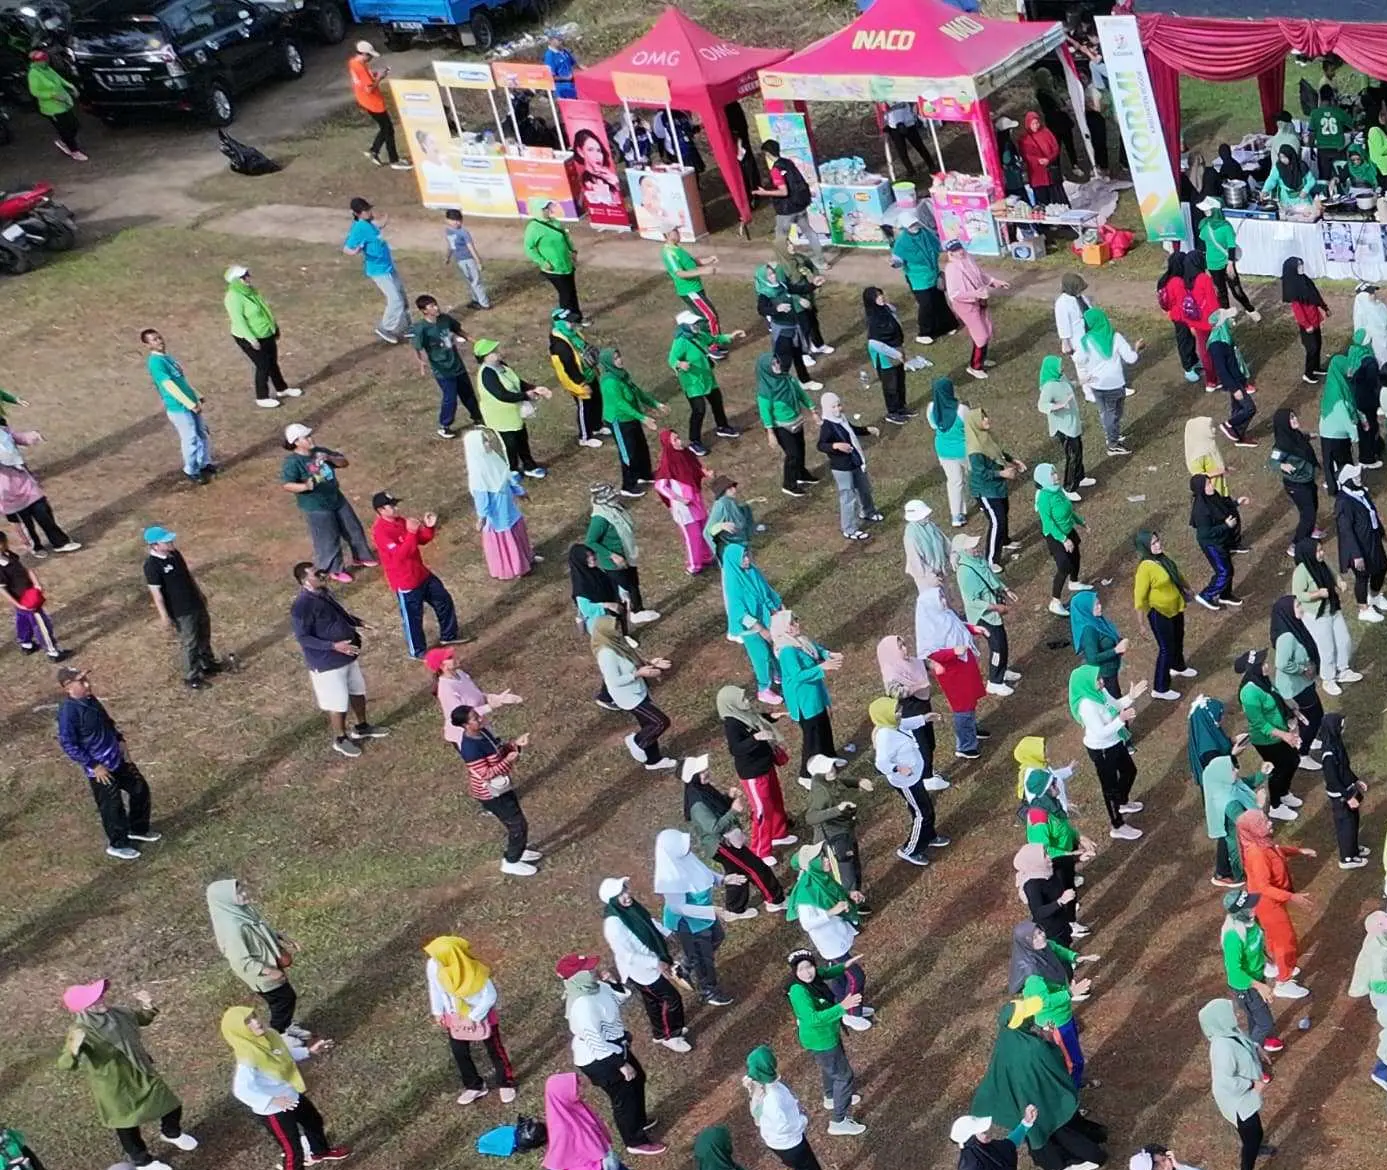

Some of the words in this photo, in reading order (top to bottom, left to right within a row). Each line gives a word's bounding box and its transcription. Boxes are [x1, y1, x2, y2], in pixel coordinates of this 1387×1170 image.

[852, 30, 916, 50] INACO
[631, 51, 680, 66] OMG
[1115, 71, 1162, 173] KORMI
[1320, 117, 1338, 135] 26
